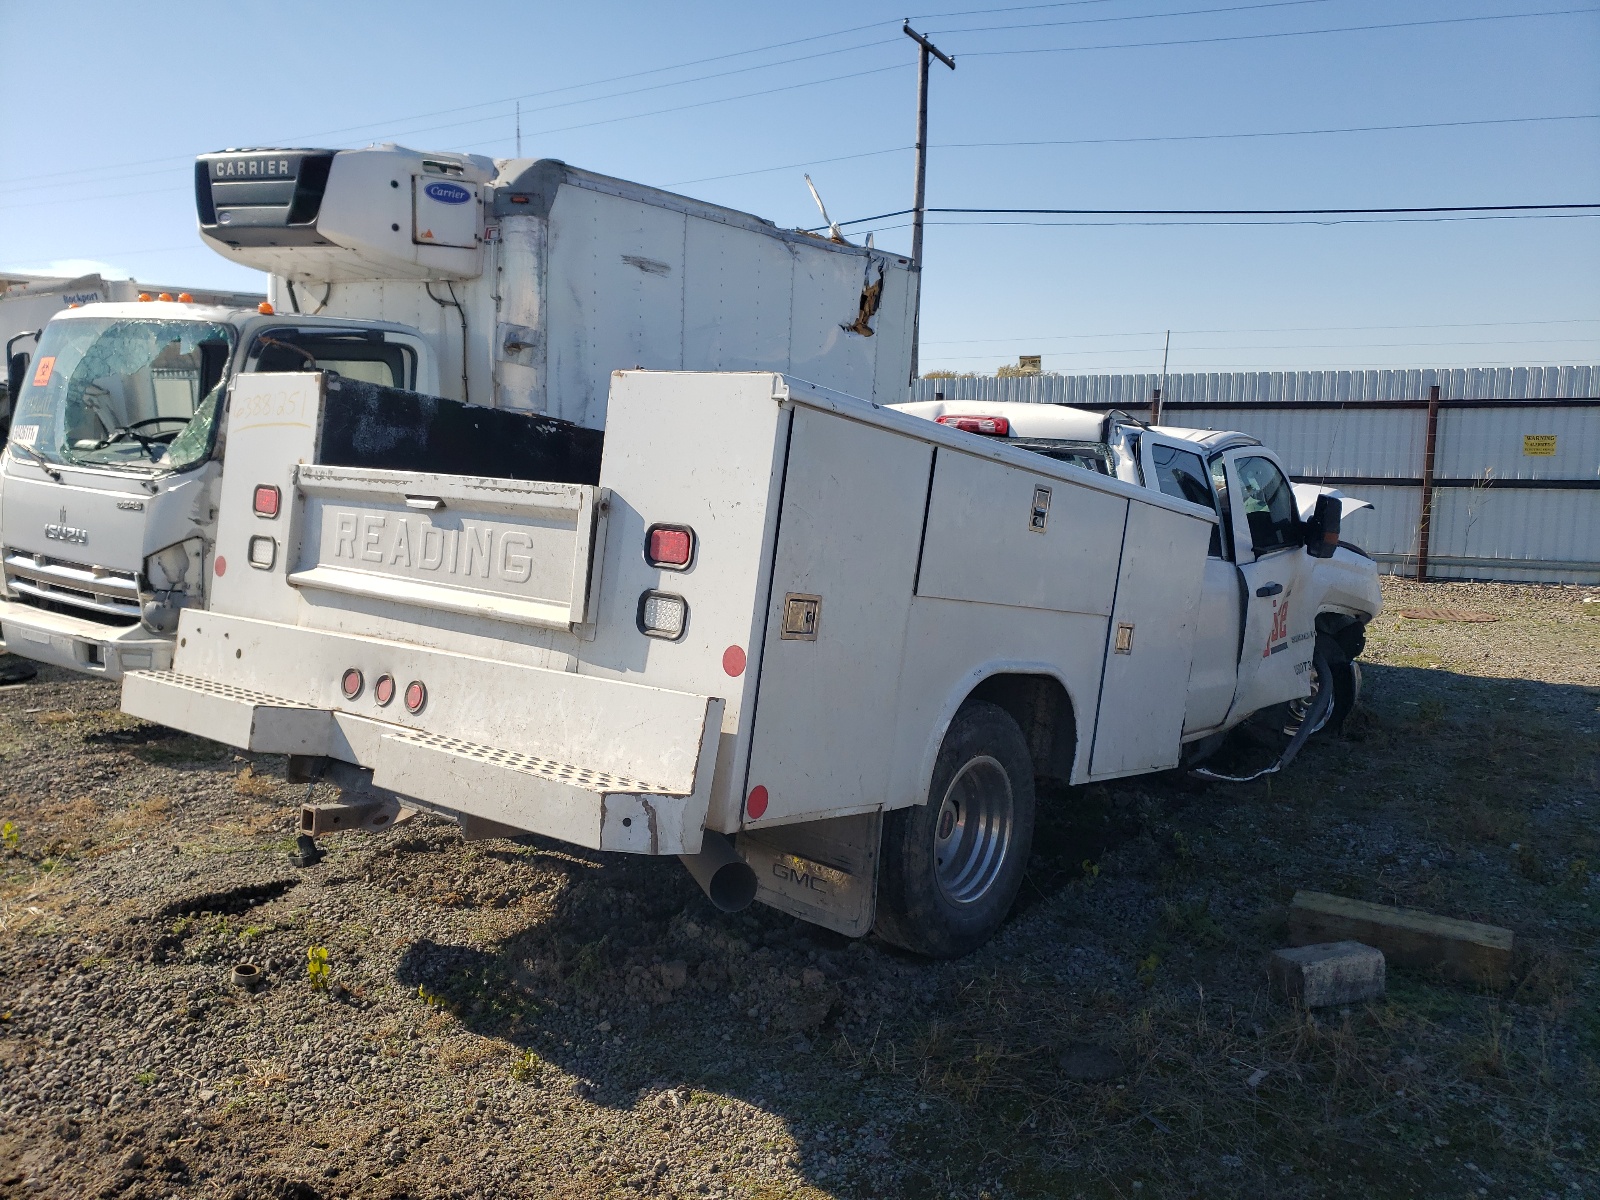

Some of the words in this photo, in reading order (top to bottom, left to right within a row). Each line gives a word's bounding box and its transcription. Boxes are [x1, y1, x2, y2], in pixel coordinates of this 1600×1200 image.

[216, 160, 289, 176] CARRIER
[429, 182, 466, 201] Carrier
[44, 523, 88, 545] ISUZU
[333, 511, 535, 585] READING
[773, 863, 827, 894] GMC
